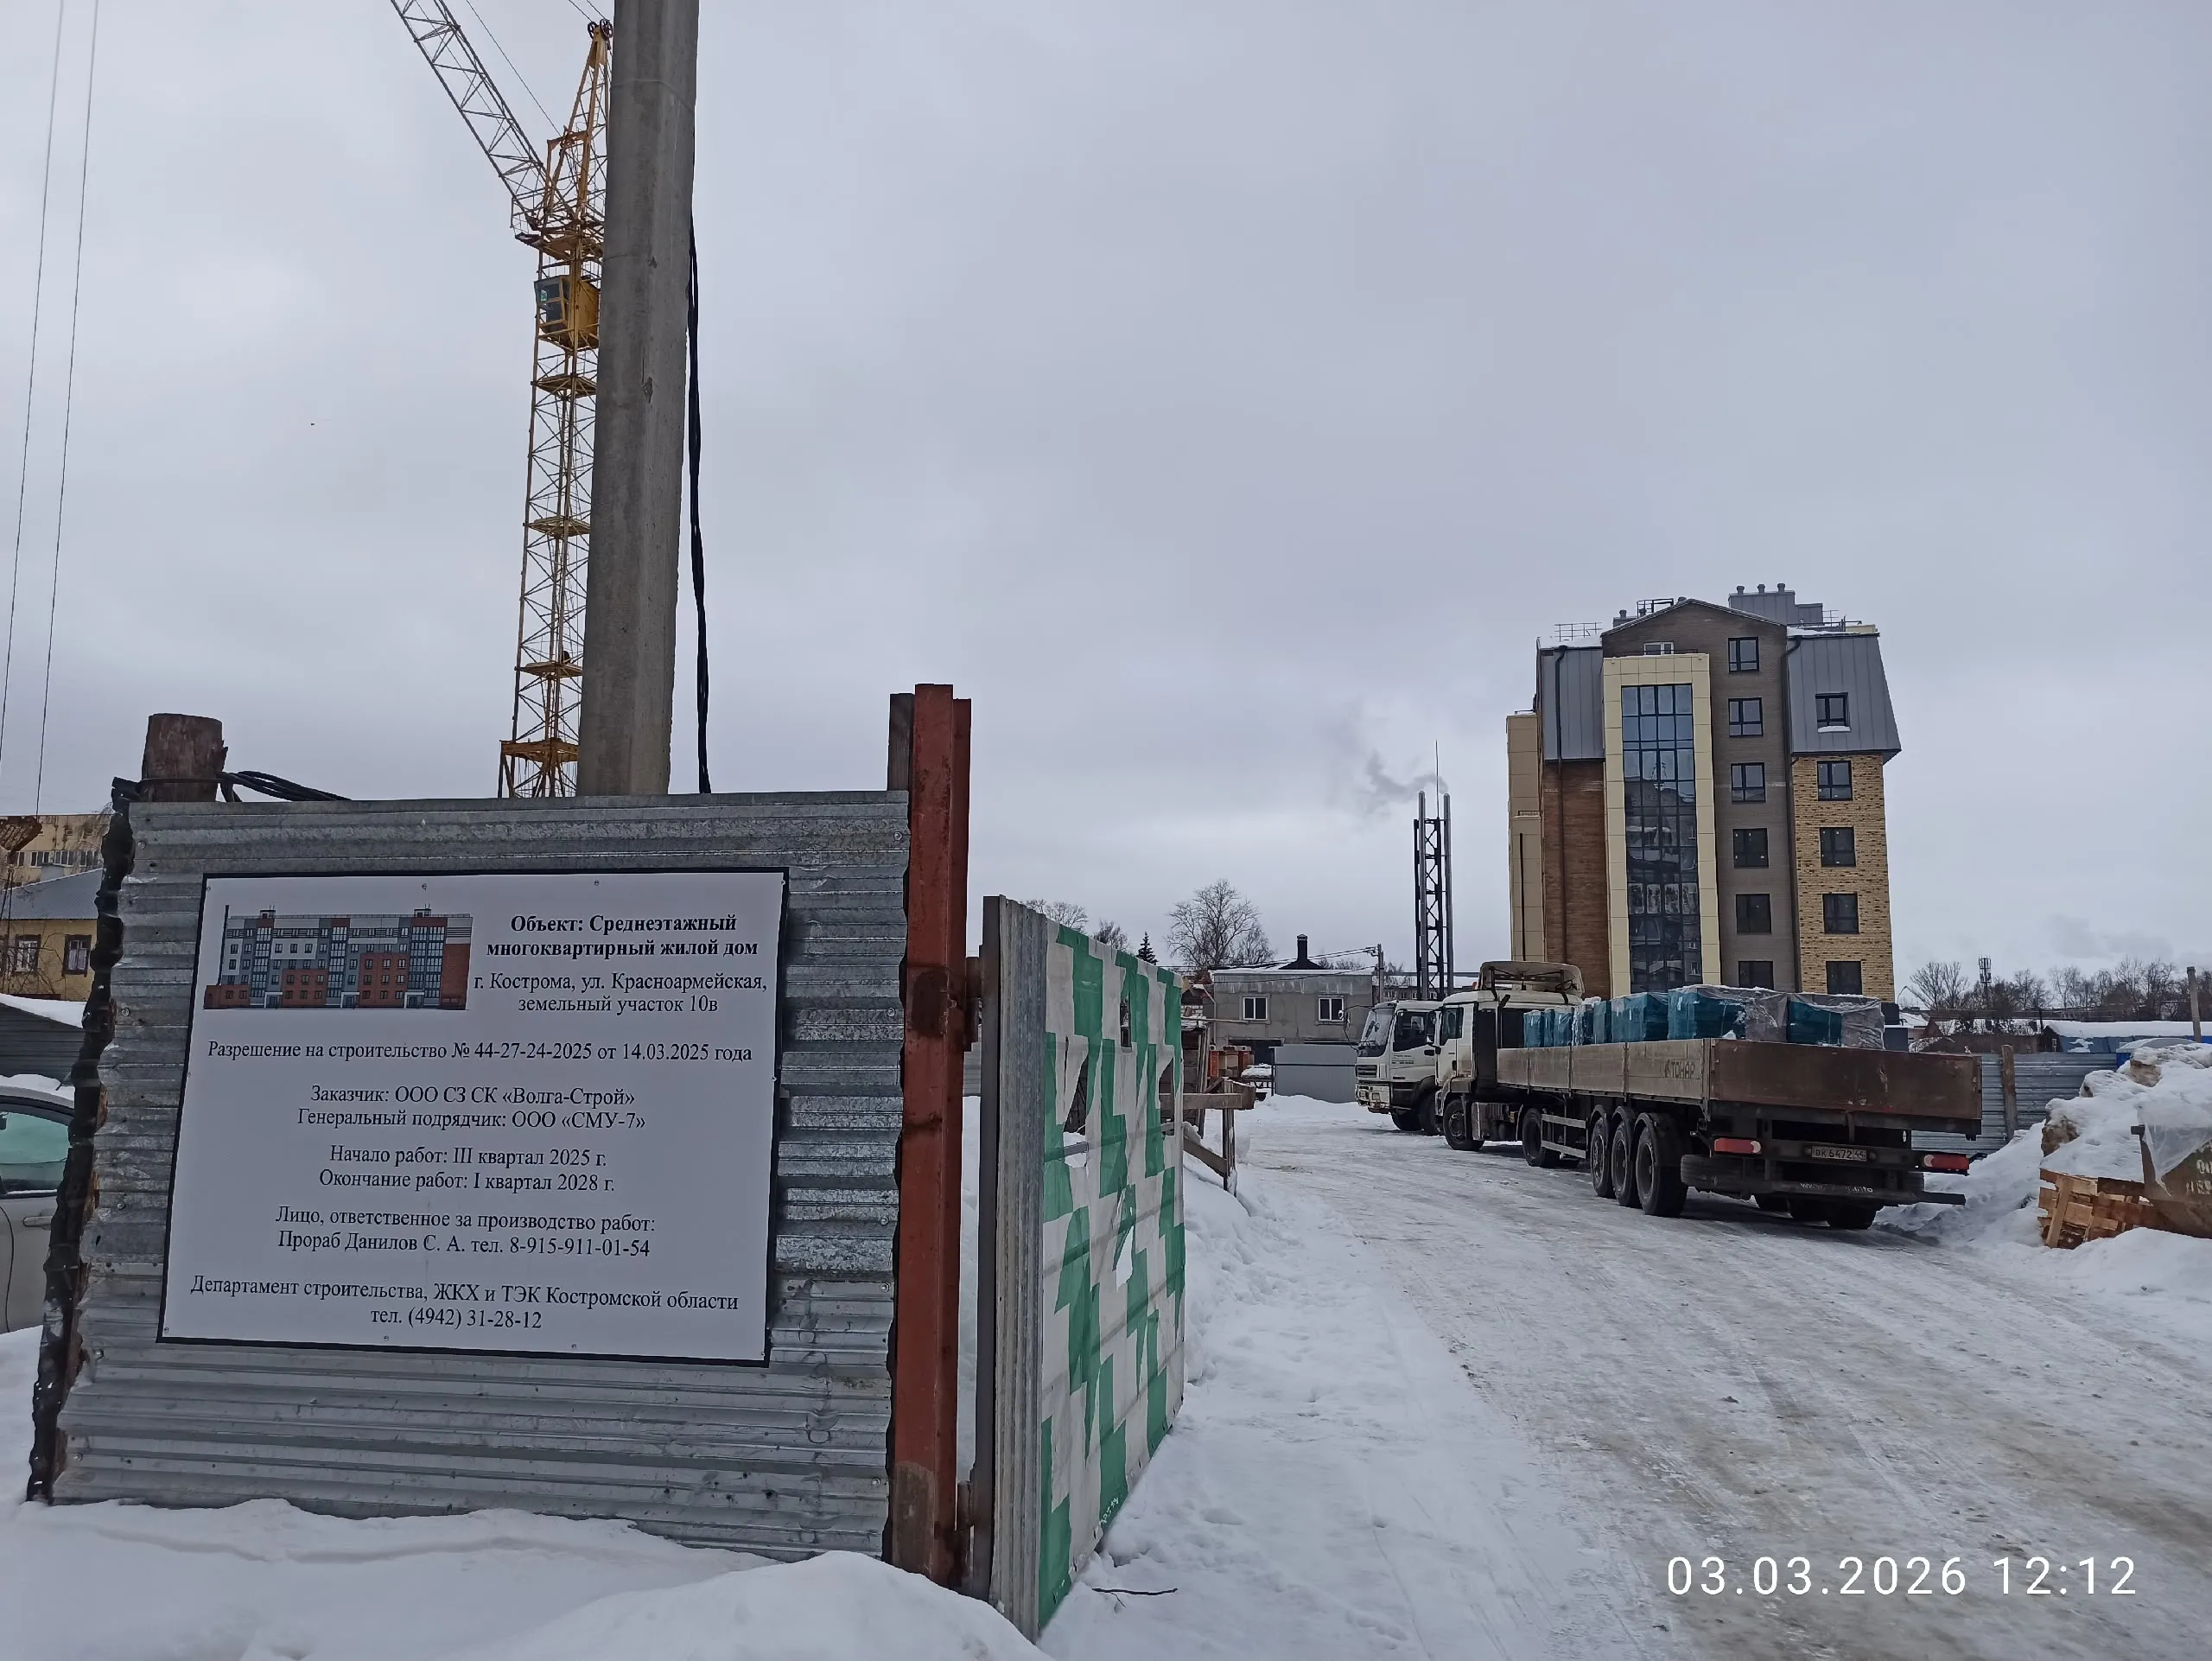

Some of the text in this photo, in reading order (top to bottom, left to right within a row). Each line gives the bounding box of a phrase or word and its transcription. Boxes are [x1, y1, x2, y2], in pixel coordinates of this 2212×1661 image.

[511, 913, 738, 936] Объект: Среднеэтажный
[486, 939, 759, 960] многоквартирный жилой дом
[474, 971, 767, 994] г. Кострома, ул. Красноармейская,
[518, 994, 718, 1016] земельный участок 10в
[207, 1041, 753, 1063] Разрешение на строительство № 44-27-24-2025 от 14.03.2025 года
[310, 1085, 635, 1110] Заказчик: ООО СЗ СК «Волга-Строй»
[296, 1108, 645, 1131] Генеральный подрядчик: ООО «СМУ-7»
[329, 1144, 391, 1162] Начало
[394, 1146, 448, 1168] работ:
[477, 1152, 544, 1169] квартал
[549, 1149, 591, 1167] 2025
[595, 1154, 607, 1167] г.
[319, 1168, 411, 1187] Окончание
[415, 1171, 467, 1192] работ:
[485, 1177, 552, 1194] квартал
[556, 1173, 598, 1192] 2028
[603, 1179, 614, 1192] г.
[275, 1206, 655, 1235] Лицо, ответственное за производство работ:
[277, 1230, 650, 1257] Прораб Данилов С. А. тел. 8-915-911-01-54
[189, 1275, 739, 1310] Департамент строительства, ЖКХ и ТЭК Костромской области
[370, 1306, 542, 1330] тел. (4942) 31-28-12
